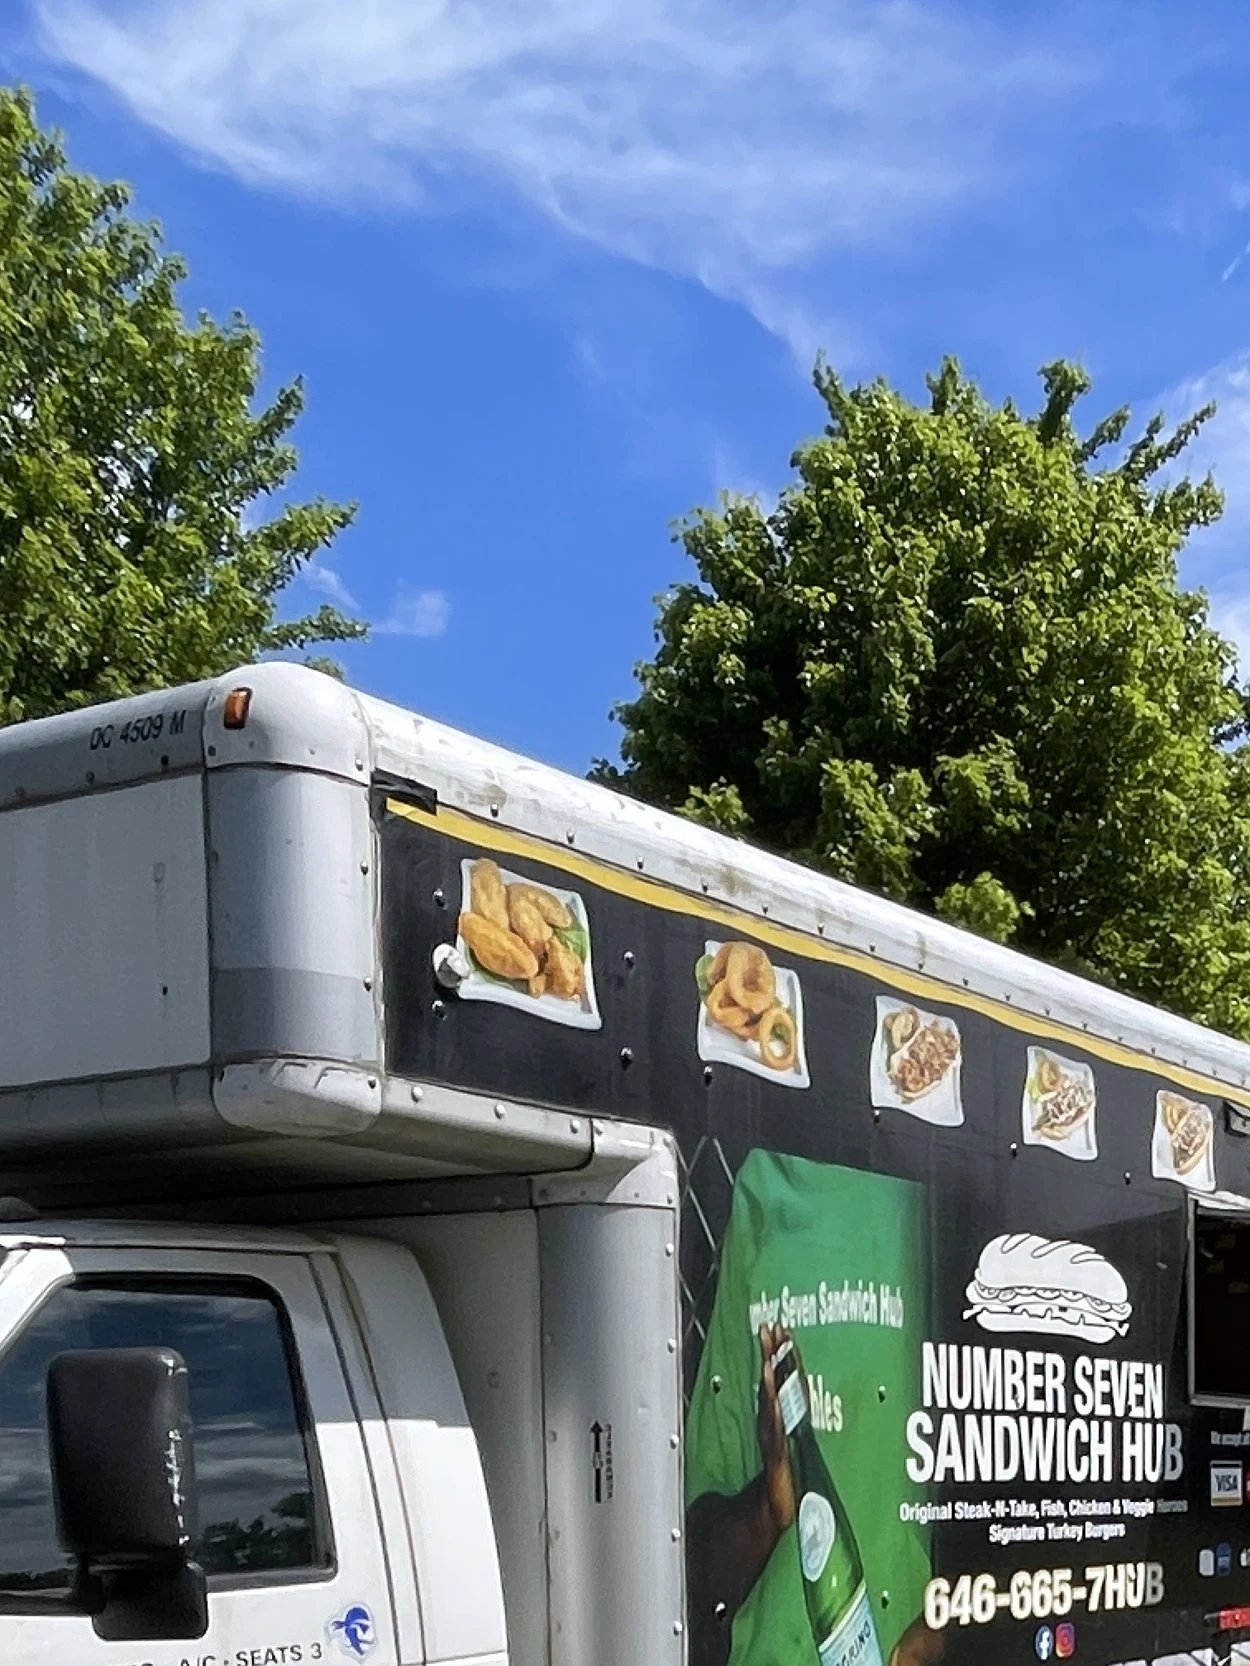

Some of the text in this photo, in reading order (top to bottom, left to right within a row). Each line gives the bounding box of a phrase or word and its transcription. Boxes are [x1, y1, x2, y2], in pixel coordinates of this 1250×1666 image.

[120, 714, 163, 743] 4509
[169, 710, 187, 735] M
[781, 1286, 817, 1329] Seven
[819, 1280, 878, 1326] Sandwich
[880, 1283, 904, 1329] Hub
[922, 1341, 1164, 1420] NUMBER SEVEN
[905, 1411, 1184, 1484] SANDWICH HUB
[1214, 1475, 1239, 1492] VISA
[900, 1502, 952, 1525] Original
[1041, 1499, 1068, 1519] Fish,
[1068, 1498, 1111, 1516] Chicken
[1113, 1499, 1121, 1516] &
[1122, 1498, 1154, 1517] Veggie
[989, 1521, 1126, 1545] Signature Turkey Burgers
[924, 1561, 1165, 1630] 646-665-7HUB
[311, 1642, 323, 1660] 3
